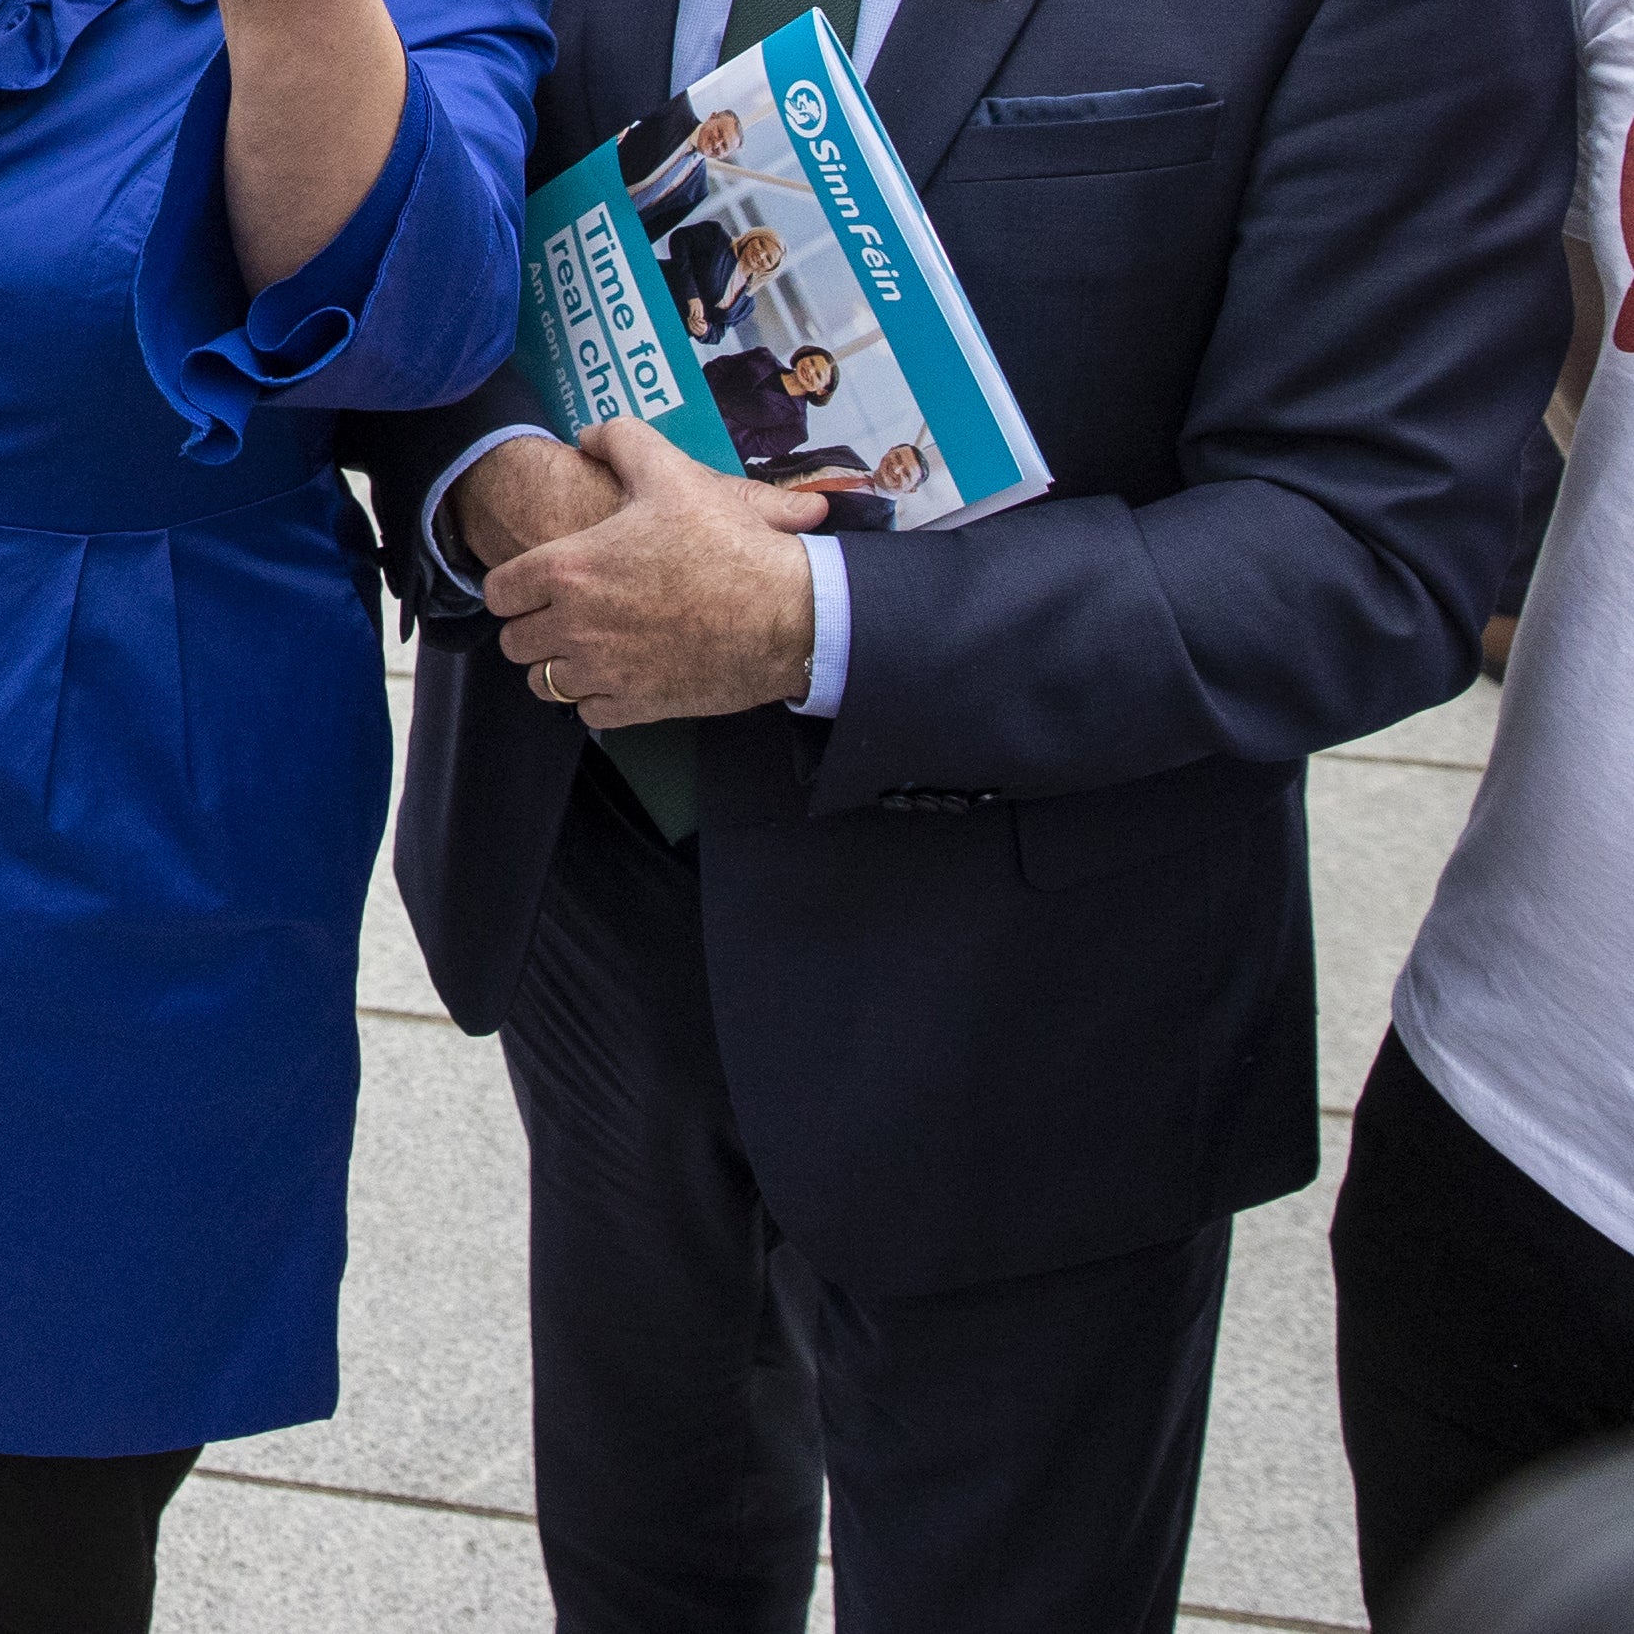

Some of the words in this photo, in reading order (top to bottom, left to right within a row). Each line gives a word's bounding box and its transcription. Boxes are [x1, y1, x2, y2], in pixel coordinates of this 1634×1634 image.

[809, 138, 860, 219] Sinn
[847, 223, 902, 303] Féin
[528, 262, 546, 305] Am
[541, 310, 561, 361] don
[551, 238, 594, 327] real
[578, 338, 620, 424] cha
[585, 211, 634, 332] Time
[626, 339, 670, 407] for
